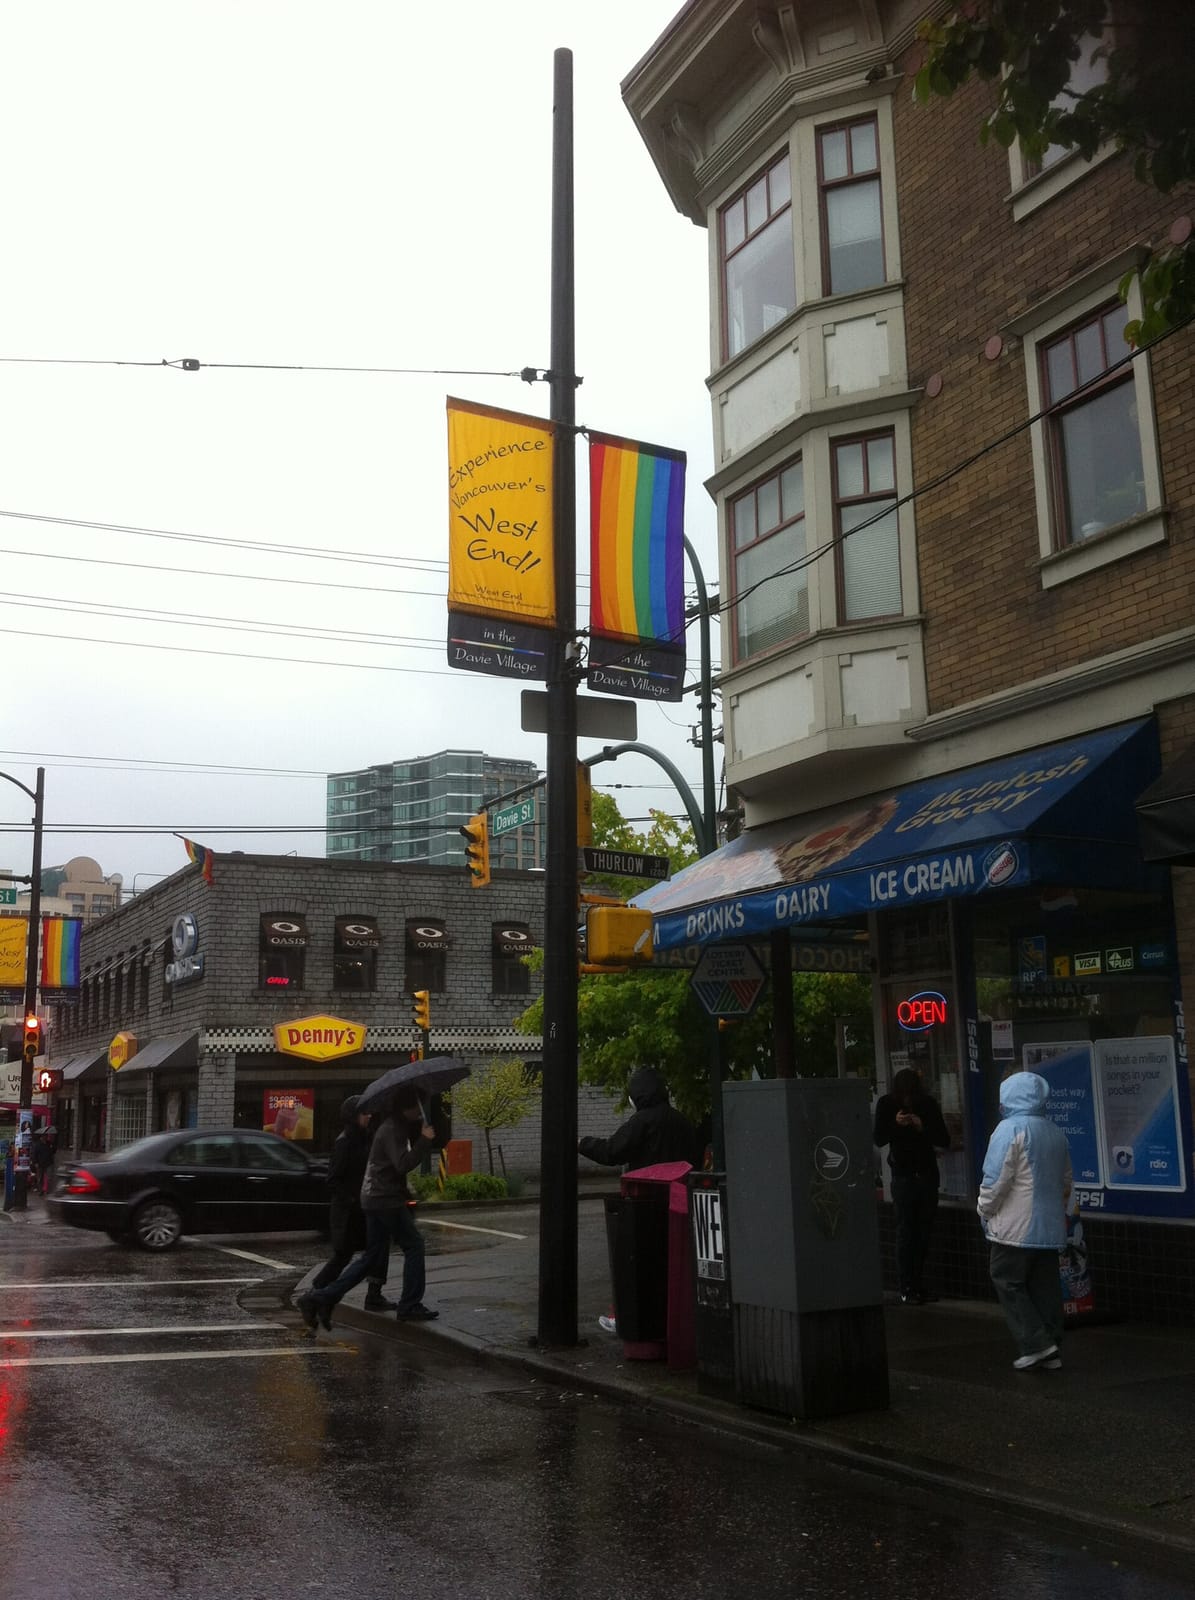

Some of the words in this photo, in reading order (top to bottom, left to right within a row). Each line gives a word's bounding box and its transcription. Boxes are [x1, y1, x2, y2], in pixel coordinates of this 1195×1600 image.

[448, 439, 545, 489] Experience
[450, 477, 546, 510] Vancouver's
[458, 508, 538, 541] West
[467, 538, 541, 574] End!!
[483, 629, 496, 640] in
[498, 629, 516, 643] the
[454, 648, 492, 665] Davie
[496, 653, 538, 674] Village
[634, 657, 651, 668] the
[593, 670, 629, 688] Davie
[631, 675, 671, 697] Village
[915, 754, 1089, 816] McIntosh
[496, 811, 519, 831] Davie
[521, 803, 531, 821] St
[895, 786, 1042, 833] Grocery
[592, 851, 644, 874] THURLOW
[686, 902, 745, 939] DRINKS
[775, 883, 830, 920] DAIRY
[870, 869, 898, 902] ICE
[903, 854, 975, 896] CREAM
[271, 936, 306, 946] OASIS
[1080, 958, 1098, 969] VISA
[1114, 957, 1132, 969] PLUS
[896, 1000, 948, 1025] OPEN
[287, 1026, 356, 1046] Denny's
[967, 1017, 980, 1073] PEPSI
[1051, 1089, 1068, 1098] best
[1069, 1089, 1086, 1101] way
[1149, 1160, 1169, 1169] rdio
